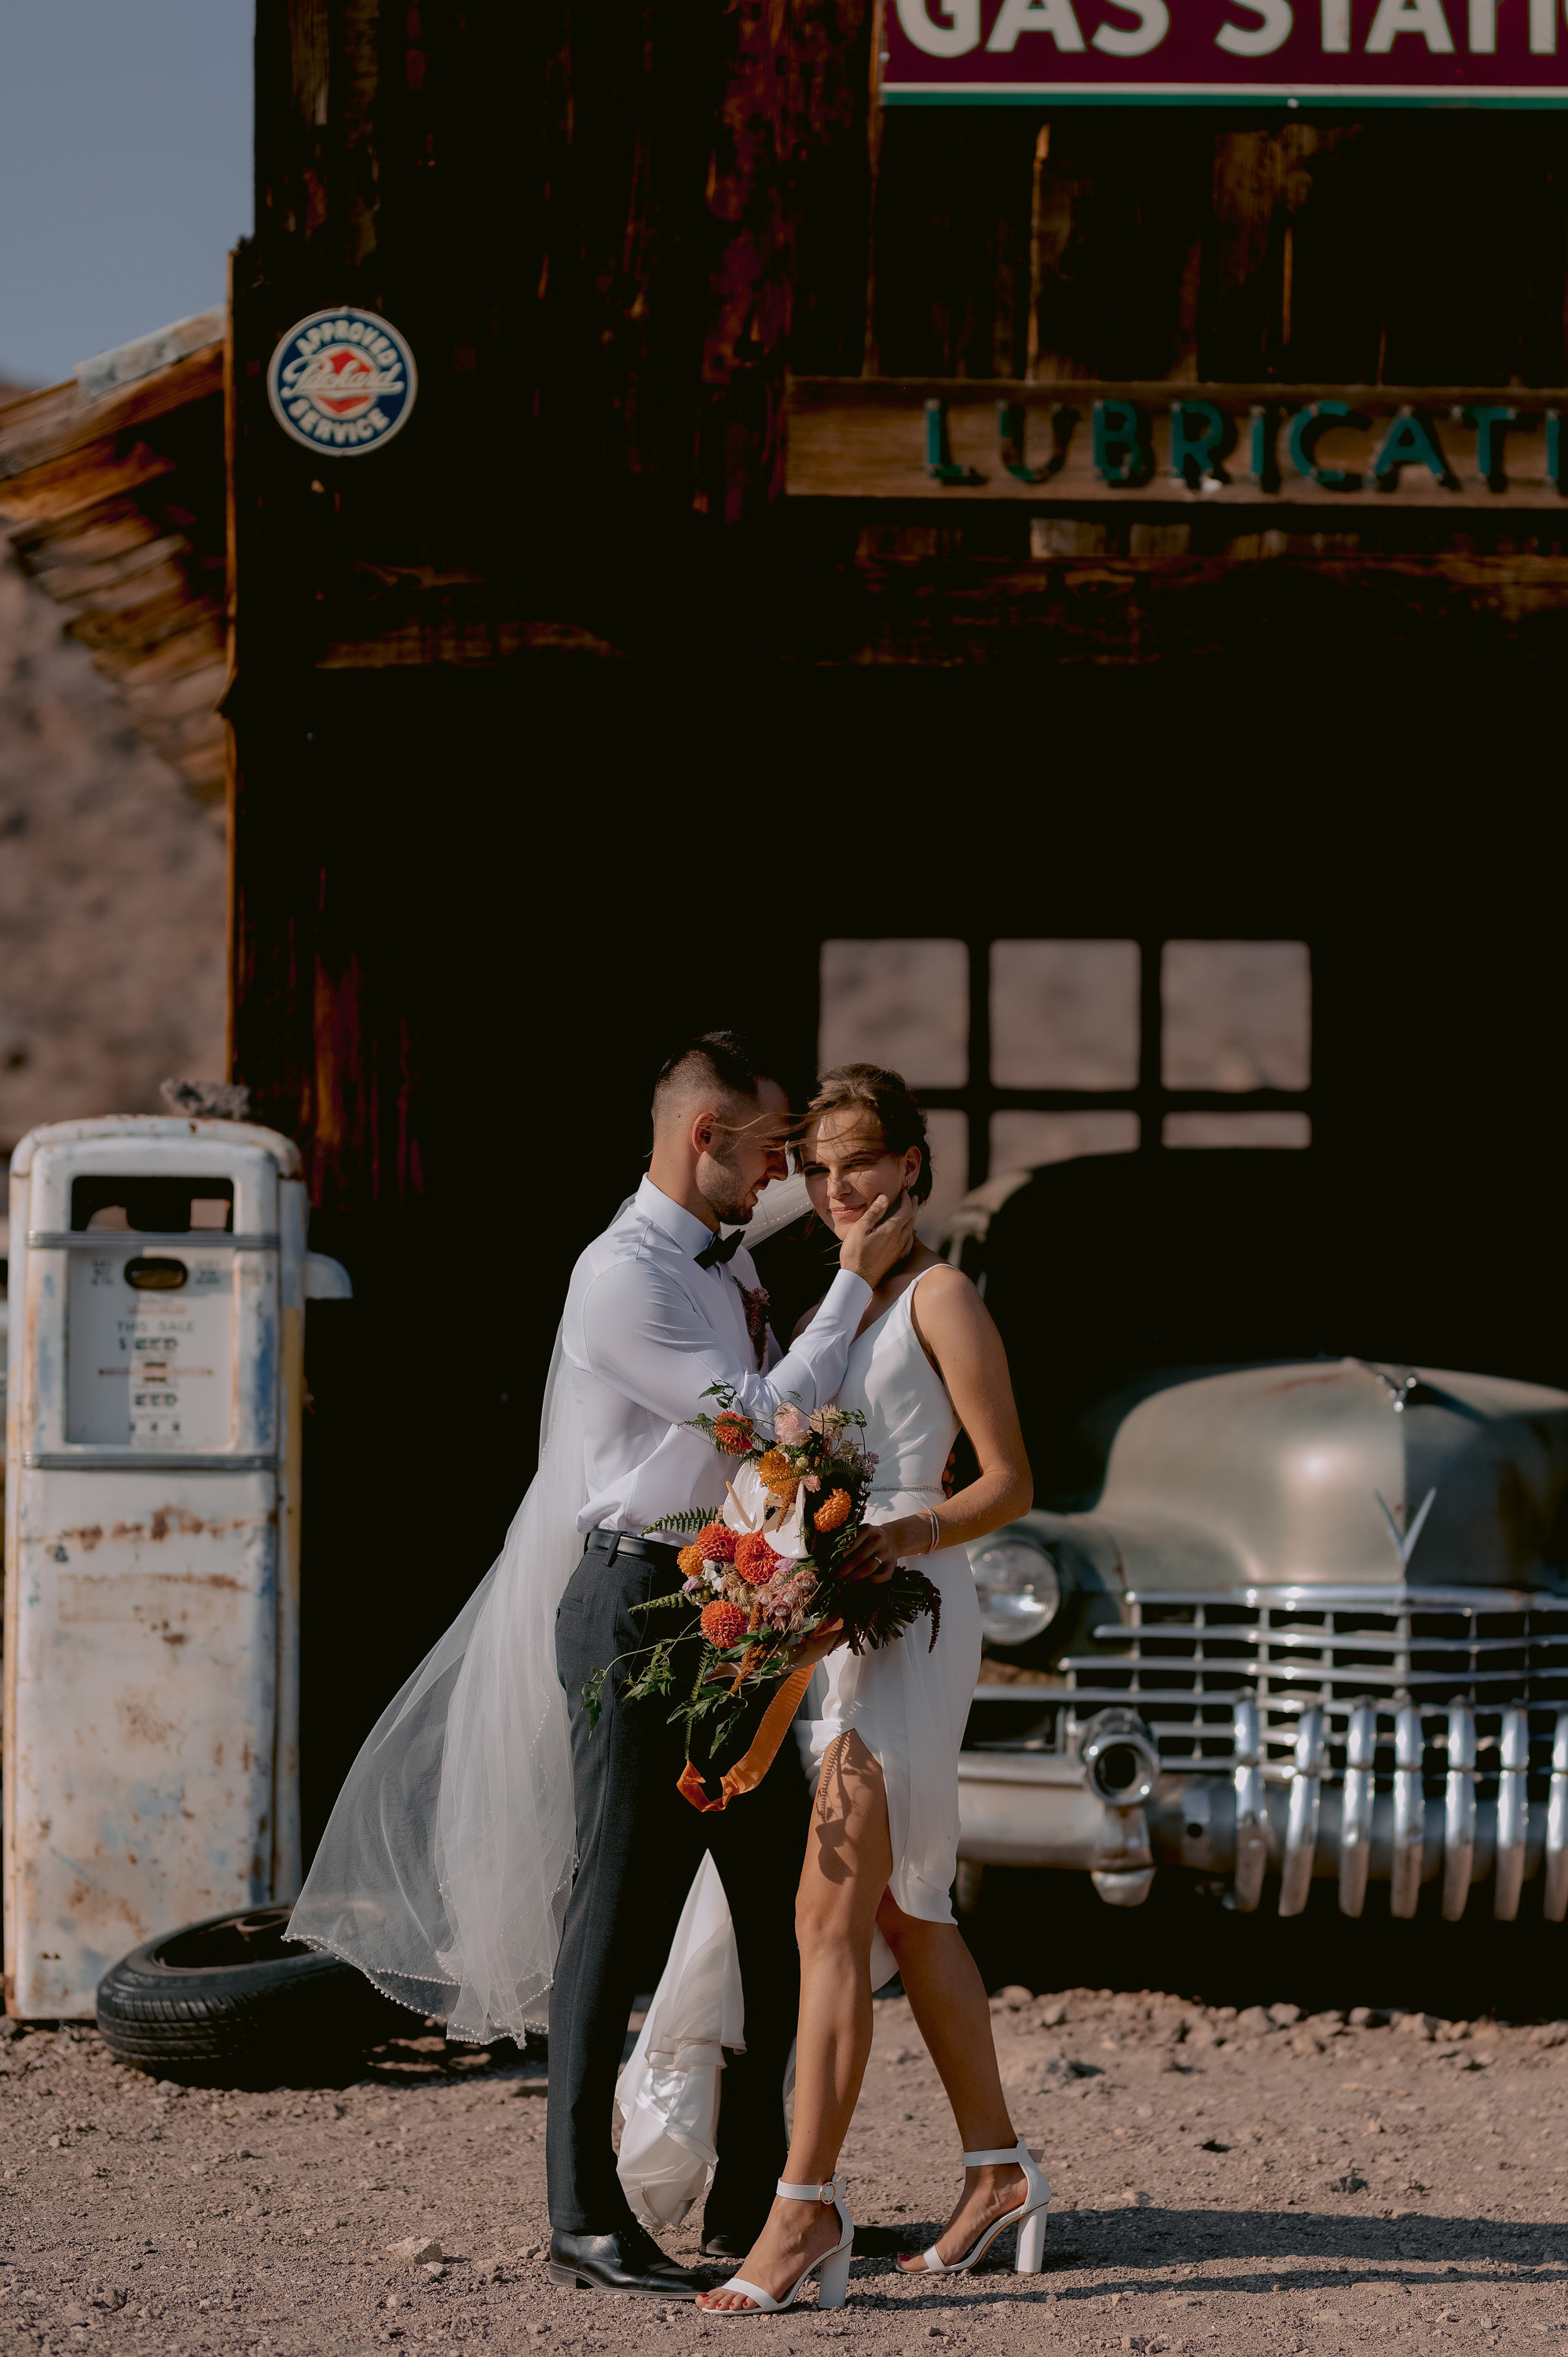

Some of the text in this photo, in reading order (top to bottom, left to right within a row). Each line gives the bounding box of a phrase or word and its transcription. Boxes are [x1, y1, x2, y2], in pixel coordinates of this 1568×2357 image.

[895, 0, 1568, 59] GAS STATI
[295, 319, 398, 368] APPROVED
[280, 354, 405, 401] Packard
[288, 398, 390, 445] SERVICE
[117, 1320, 195, 1332] THIS SALE
